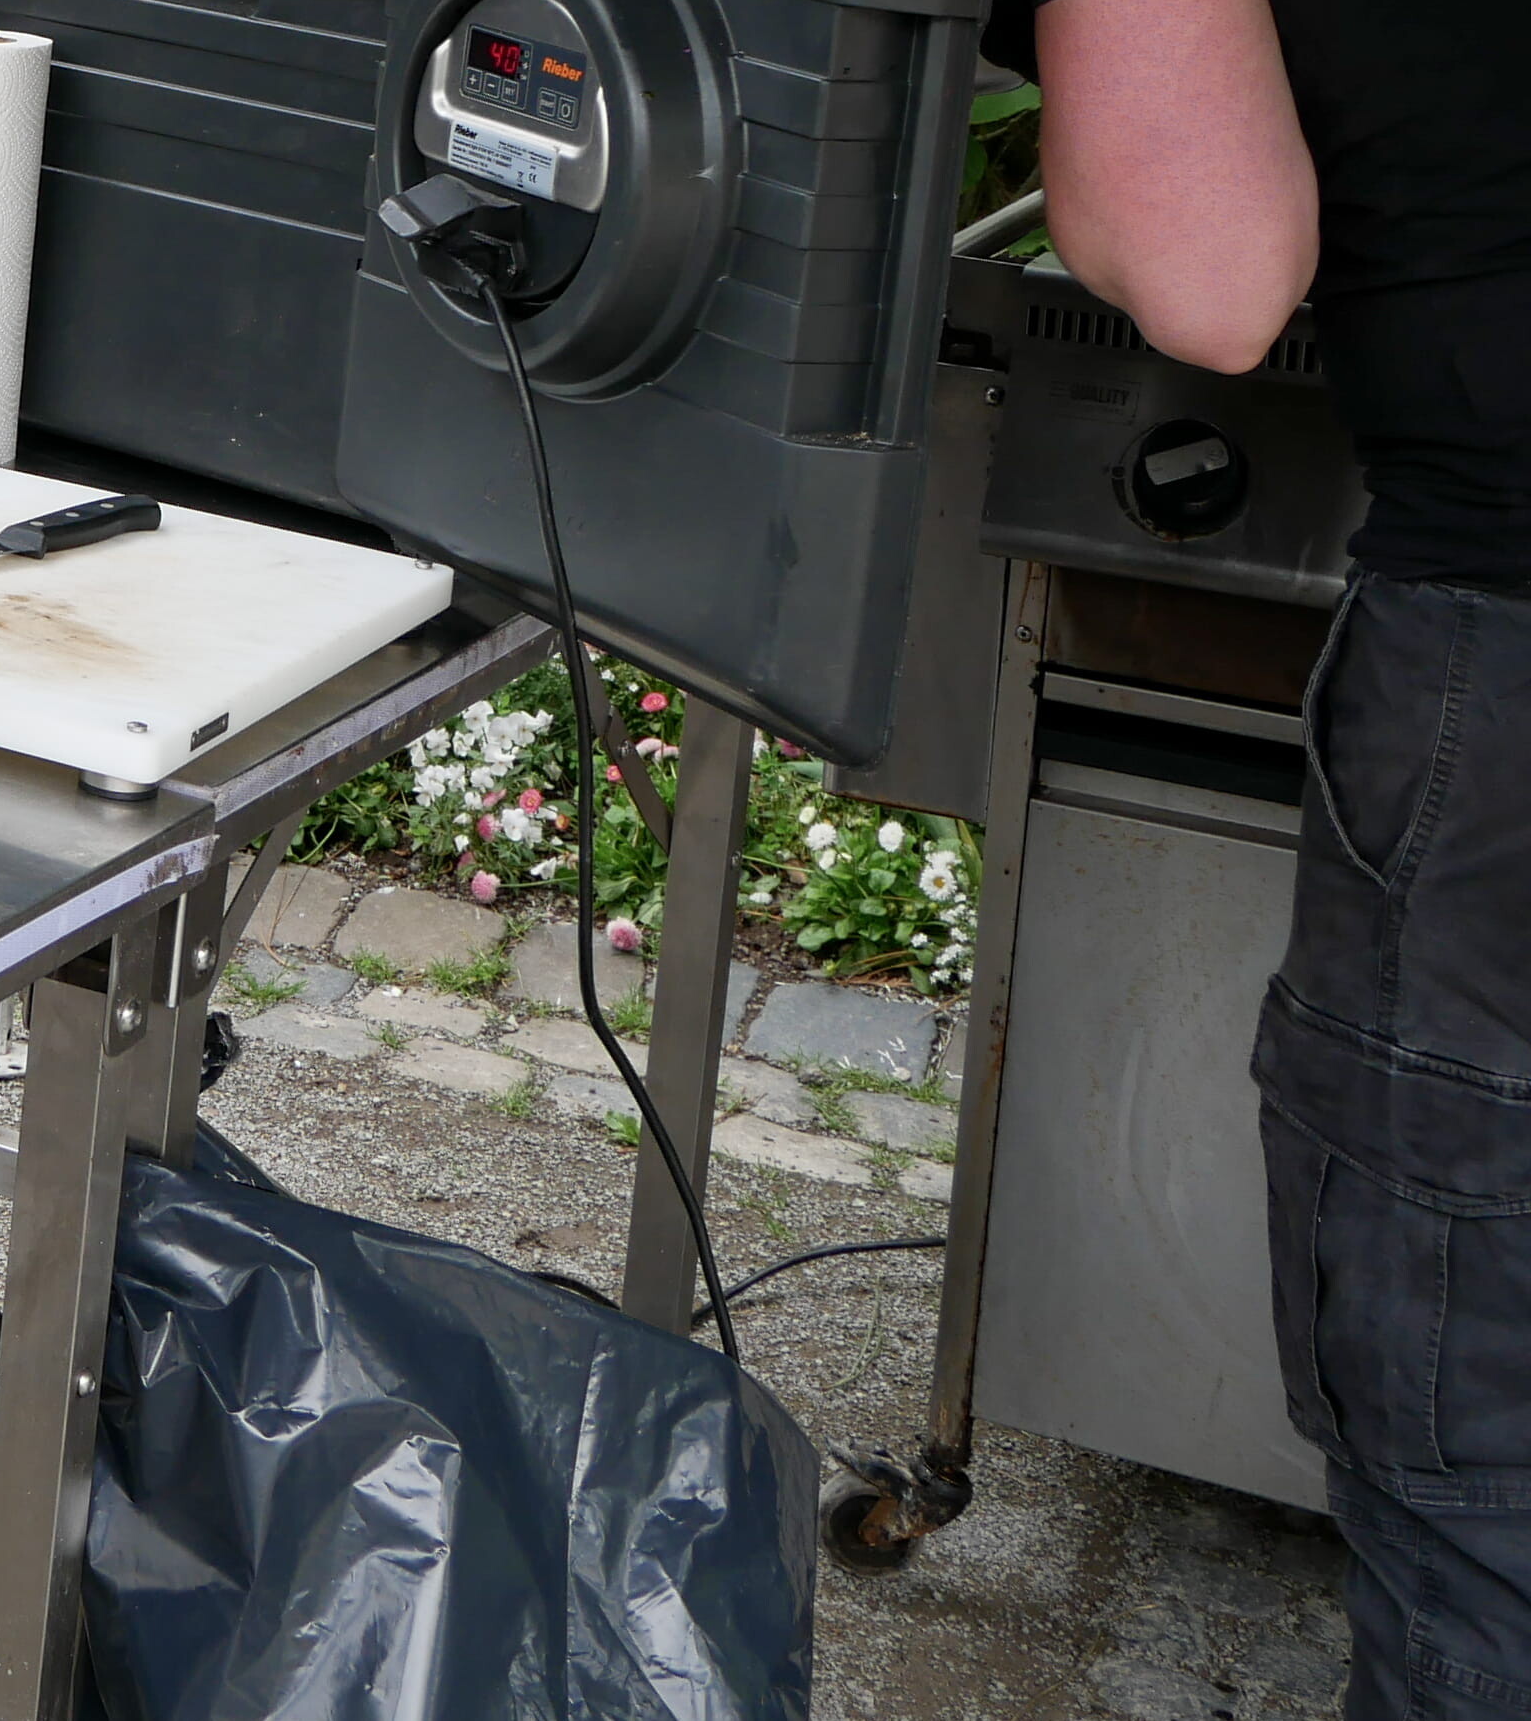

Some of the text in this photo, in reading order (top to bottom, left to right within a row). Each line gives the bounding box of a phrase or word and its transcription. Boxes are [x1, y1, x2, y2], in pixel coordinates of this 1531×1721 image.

[490, 42, 521, 73] 40
[542, 57, 583, 81] Rieber
[455, 124, 478, 140] Rieber
